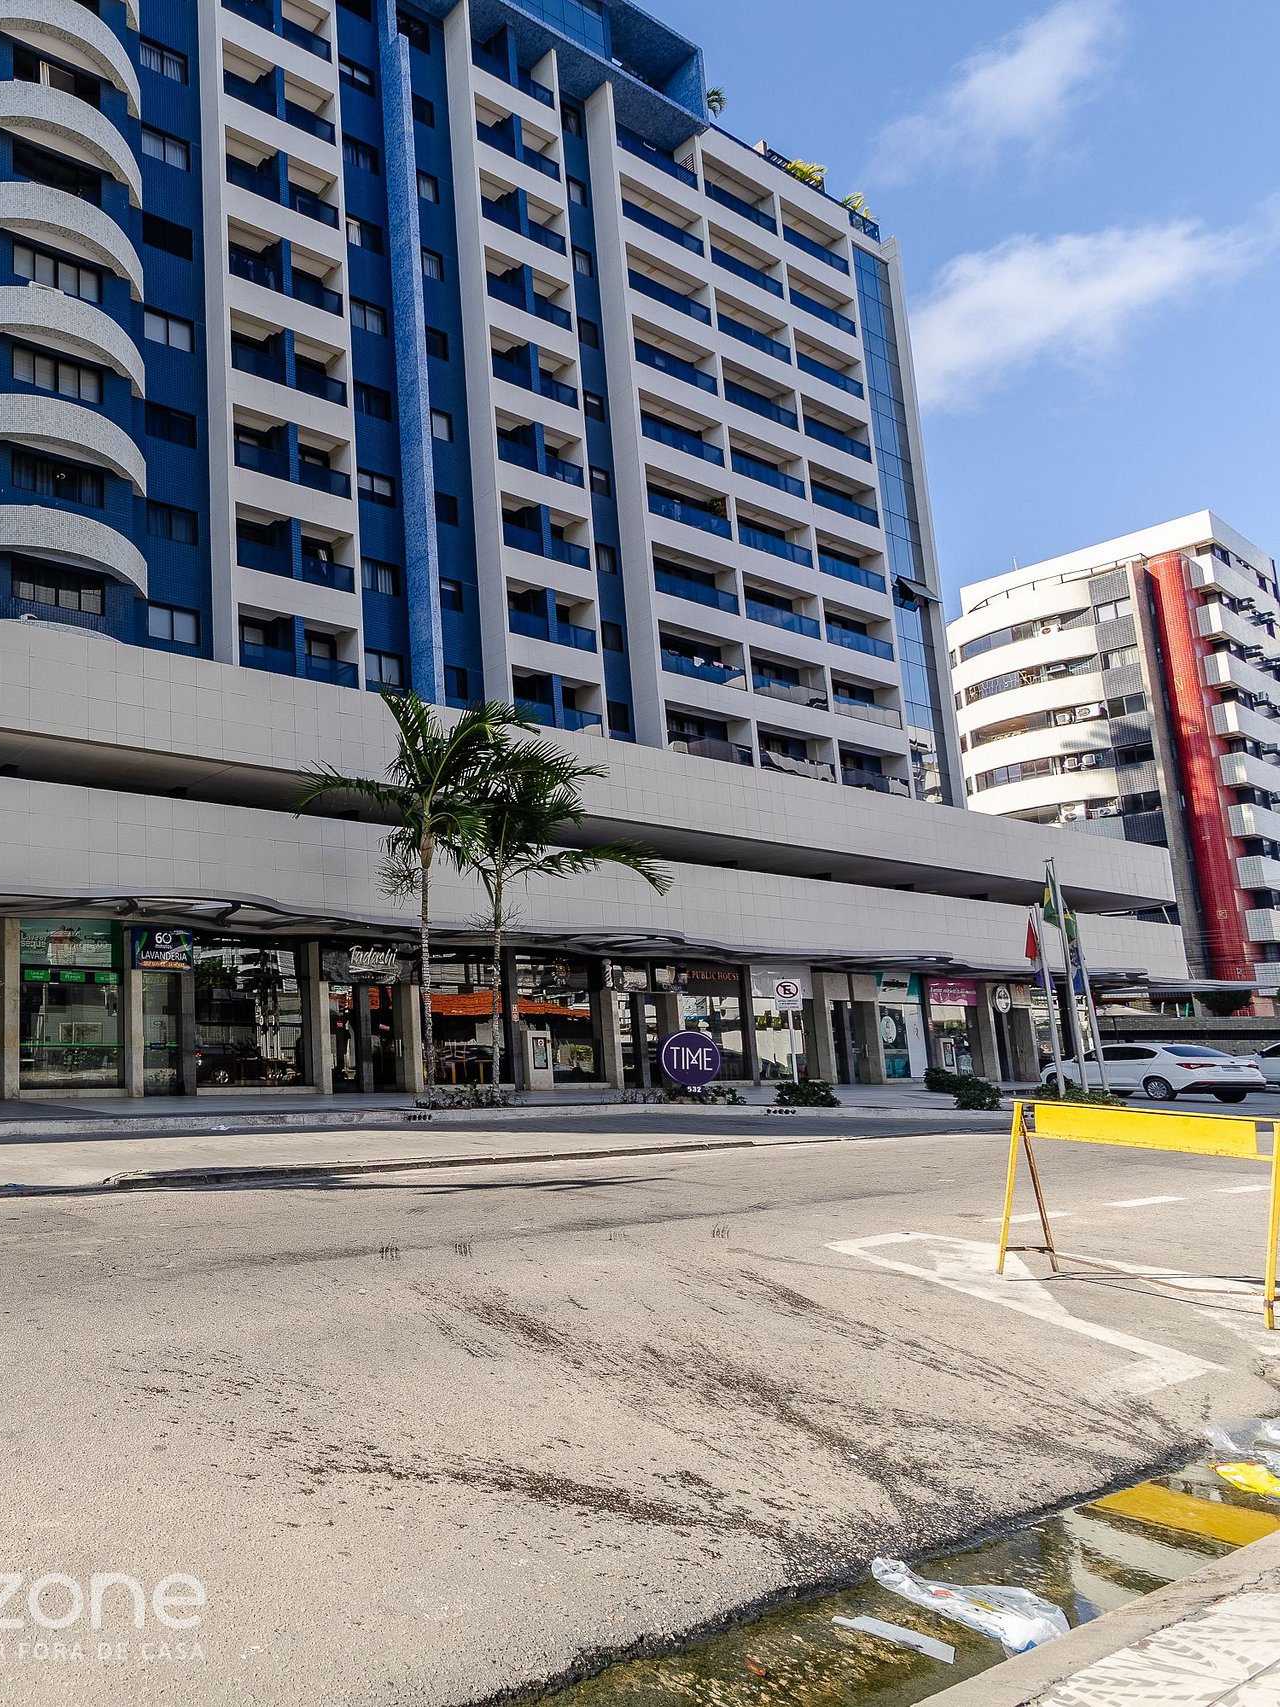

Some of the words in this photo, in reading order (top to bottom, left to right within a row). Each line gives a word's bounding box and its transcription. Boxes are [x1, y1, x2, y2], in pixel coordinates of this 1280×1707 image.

[155, 932, 173, 945] 60
[141, 950, 188, 961] LAVANDERIA
[348, 945, 399, 967] Tadashi
[691, 970, 718, 980] PUBLIC
[717, 971, 740, 981] HOUSE
[669, 1046, 714, 1071] TIME
[687, 1085, 702, 1093] 532
